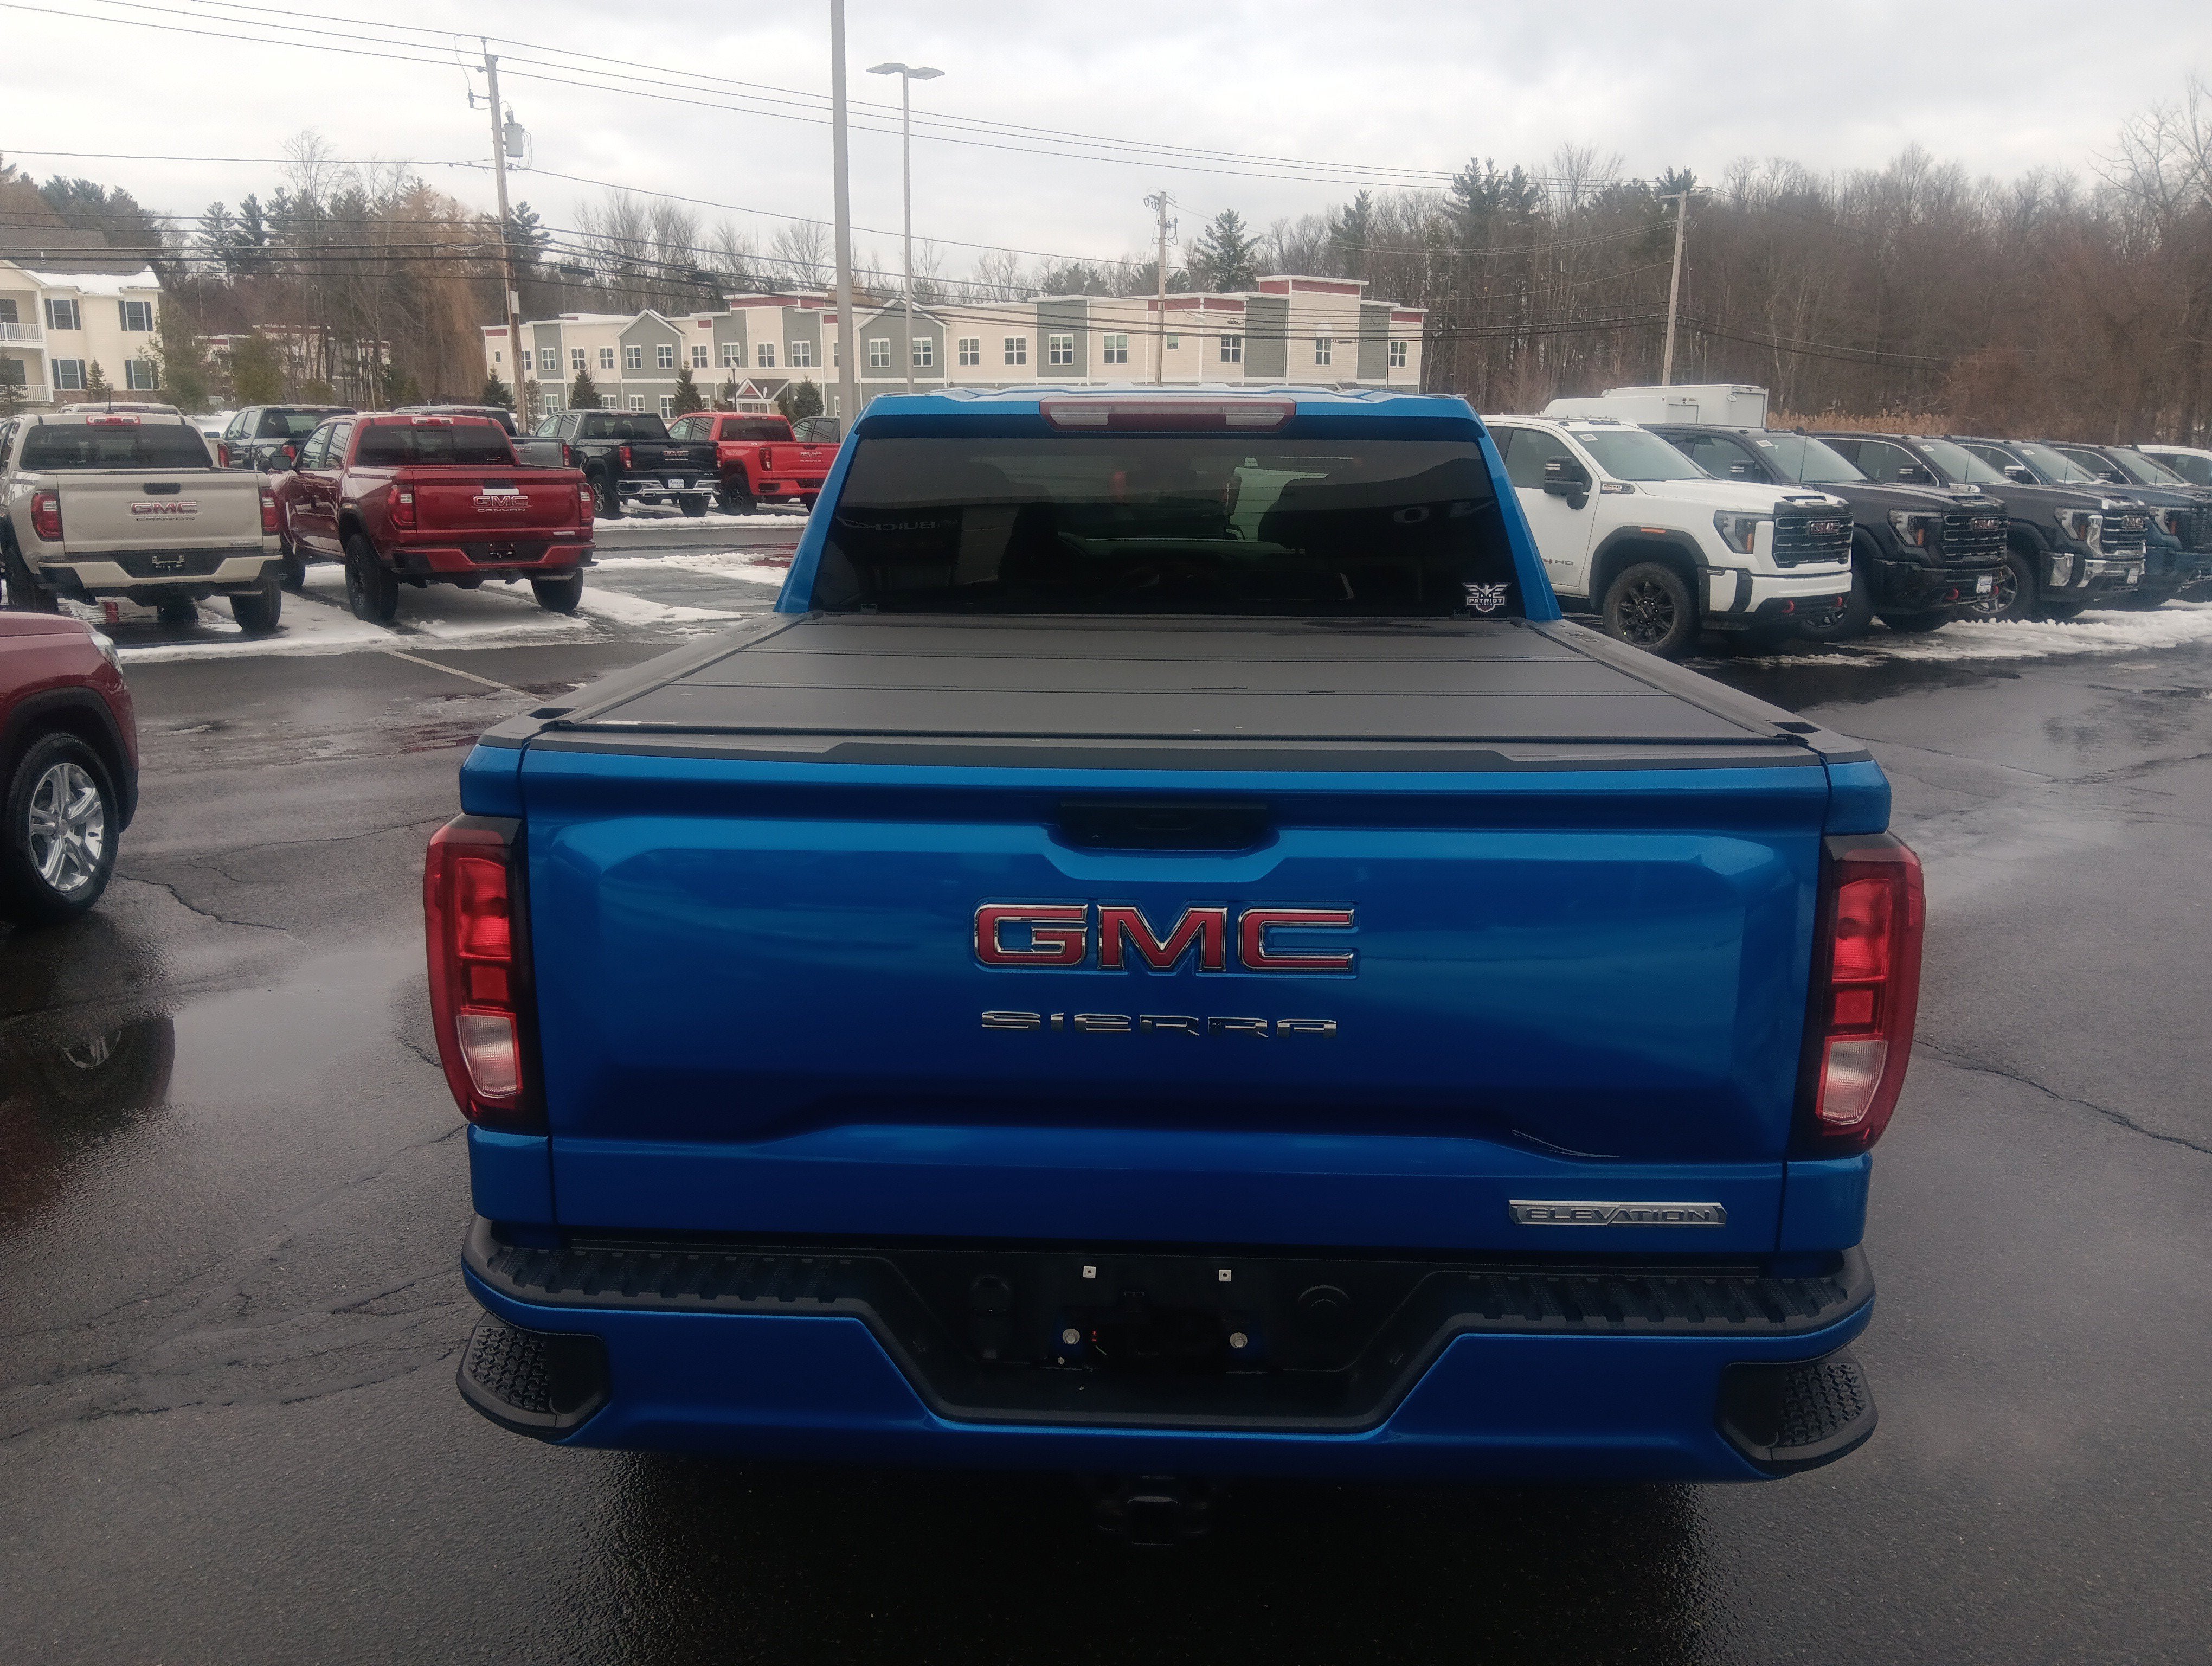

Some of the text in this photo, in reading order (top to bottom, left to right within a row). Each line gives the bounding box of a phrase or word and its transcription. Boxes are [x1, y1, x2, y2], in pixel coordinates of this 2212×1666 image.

[131, 502, 198, 514] GMC
[473, 496, 529, 507] GMC
[975, 903, 1355, 972] GMC
[981, 1010, 1338, 1038] SIERRA
[1525, 1207, 1711, 1221] ELEVATION
